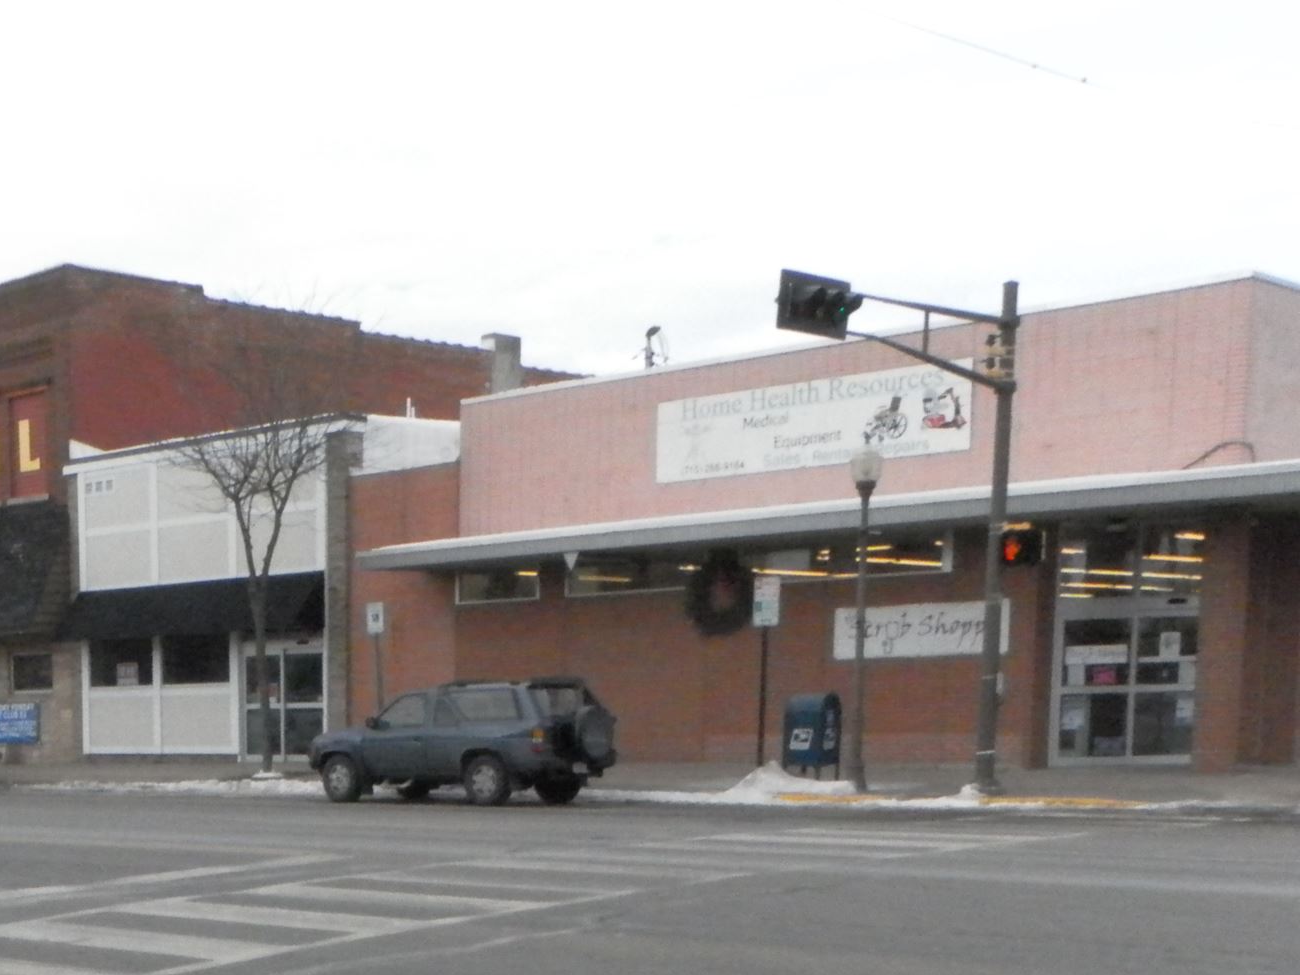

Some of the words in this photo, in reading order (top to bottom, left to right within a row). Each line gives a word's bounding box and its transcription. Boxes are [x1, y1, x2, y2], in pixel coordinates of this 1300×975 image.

[682, 399, 742, 421] Home
[750, 382, 820, 411] Health
[829, 370, 944, 400] Resources
[742, 410, 789, 430] Medical
[773, 430, 842, 448] Equipment
[917, 611, 986, 649] Shopp
